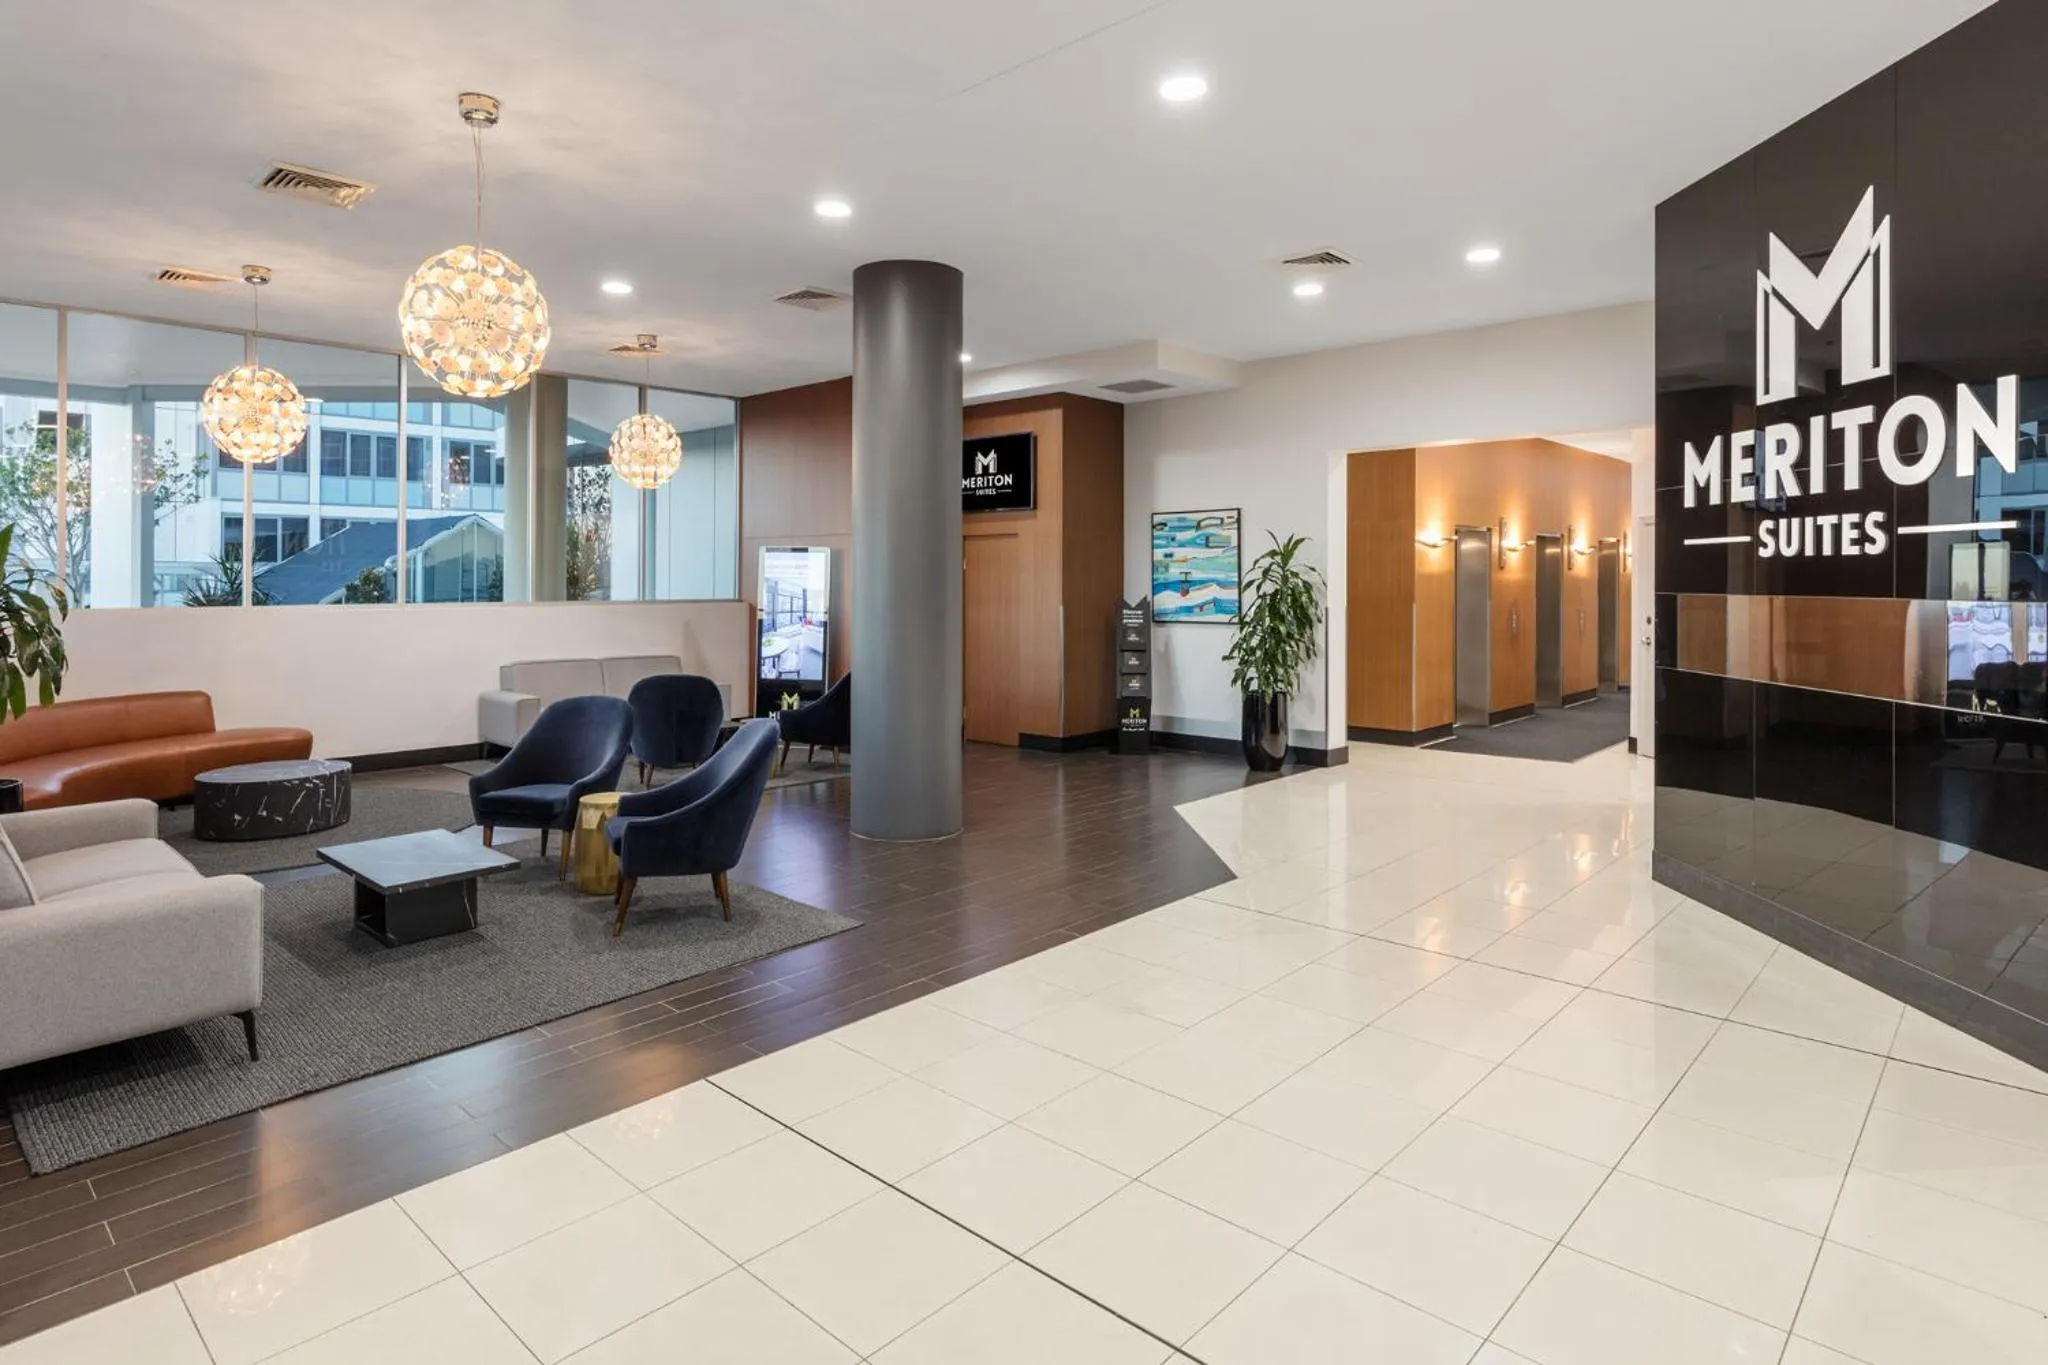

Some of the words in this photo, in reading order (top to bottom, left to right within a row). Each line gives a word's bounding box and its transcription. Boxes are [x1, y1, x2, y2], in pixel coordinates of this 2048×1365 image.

[1684, 373, 2020, 509] MERITON
[961, 474, 1013, 488] MERITON
[1758, 510, 1888, 558] SUITES
